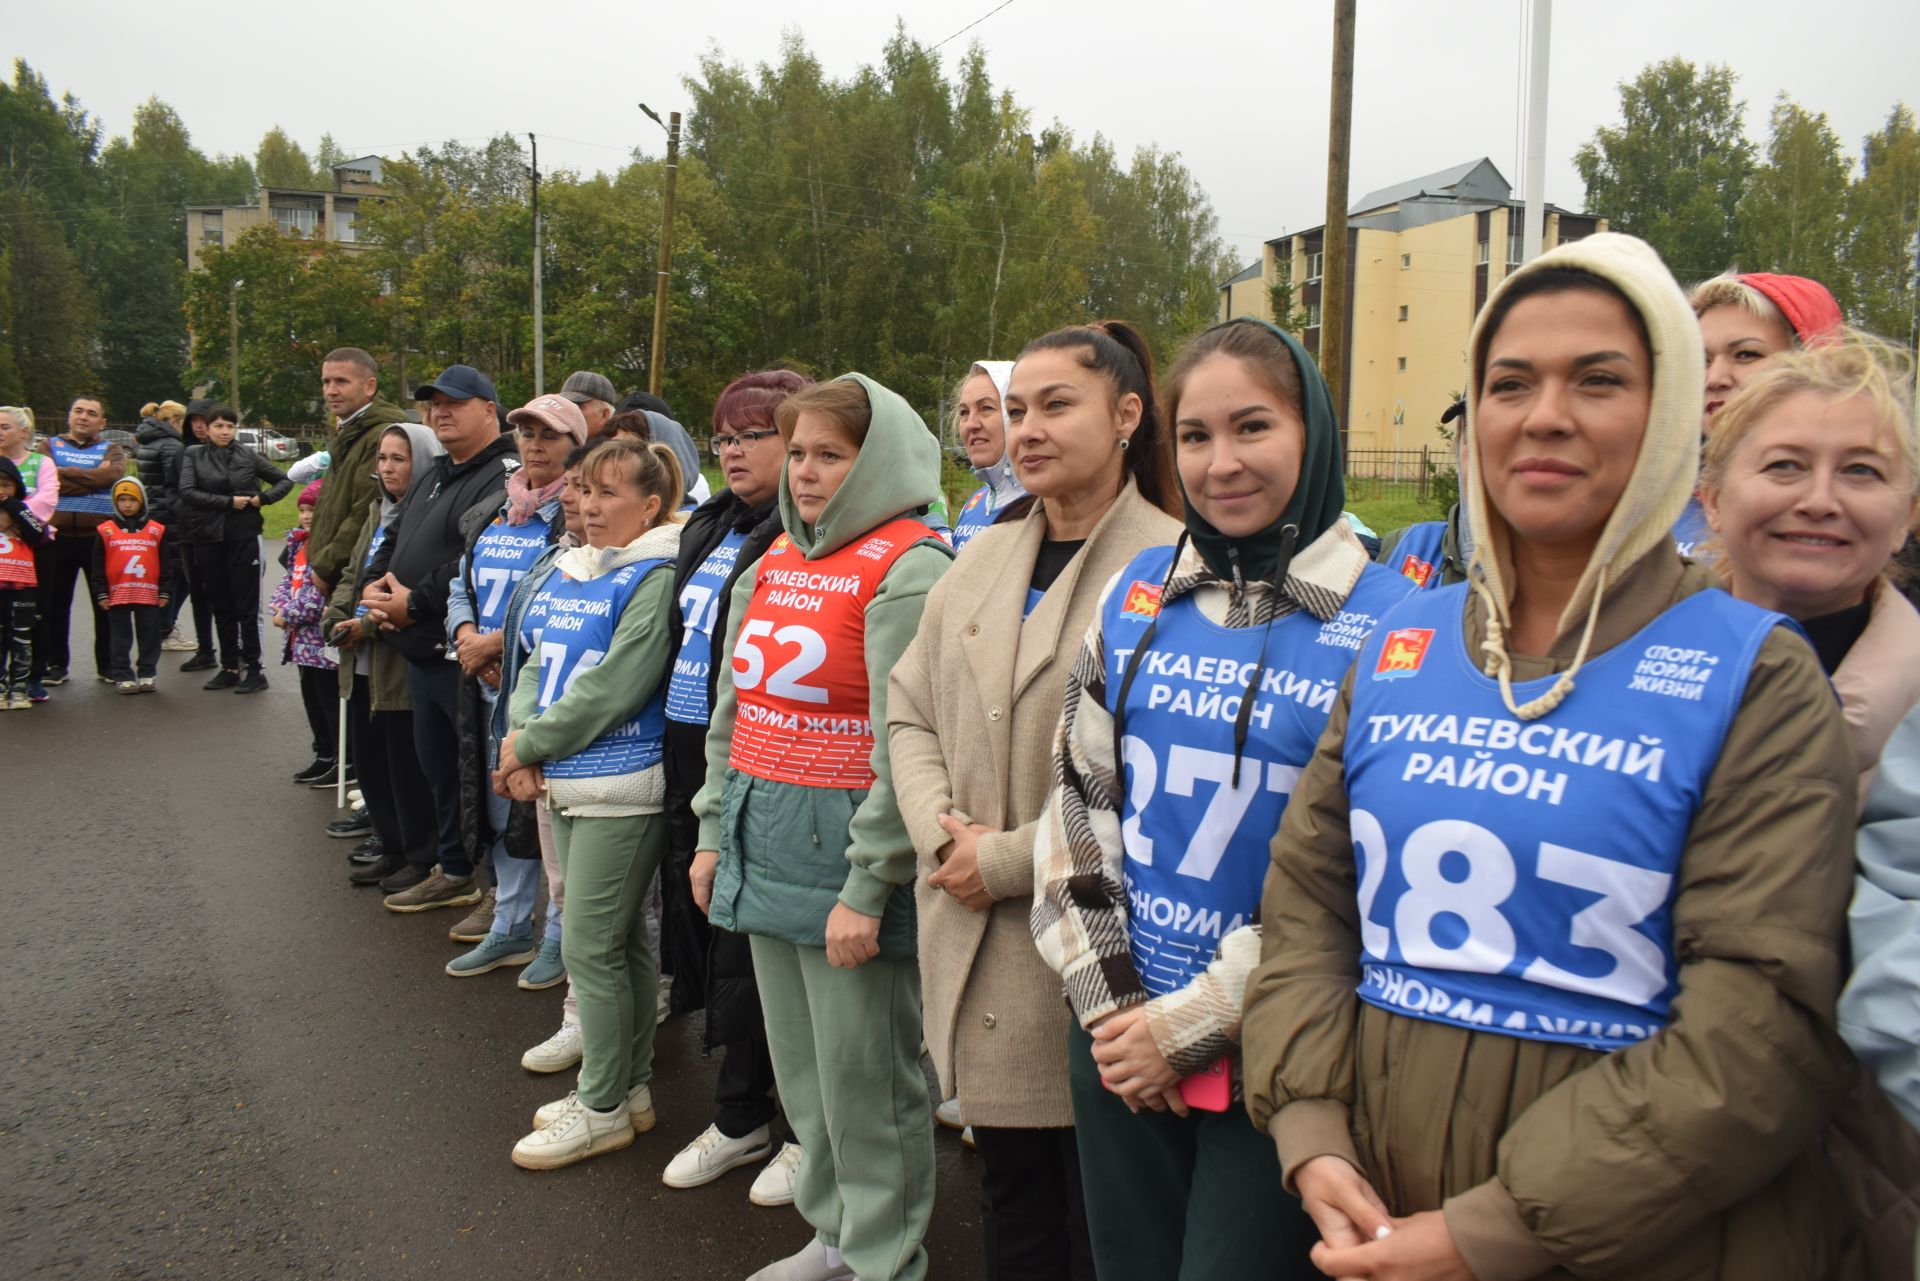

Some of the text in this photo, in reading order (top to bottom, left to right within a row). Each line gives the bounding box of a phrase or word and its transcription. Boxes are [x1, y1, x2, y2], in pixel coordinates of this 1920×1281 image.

[481, 546, 523, 560] РАЙОН
[123, 555, 147, 578] 4
[697, 561, 733, 579] РАЙОН
[760, 569, 861, 597] УКАЕВСКИЙ
[764, 588, 824, 612] РАЙОН
[545, 613, 585, 632] РАЙОН
[731, 618, 829, 704] 52
[1644, 644, 1708, 665] СПОРТ
[1635, 659, 1713, 684] НОРМА
[1626, 674, 1705, 701] ЖИЗНИ
[1148, 684, 1274, 730] РАЙОН
[1368, 713, 1666, 783] ТУКАЕВСКИЙ
[1402, 750, 1569, 806] РАЙОН
[1350, 808, 1672, 1006] 283
